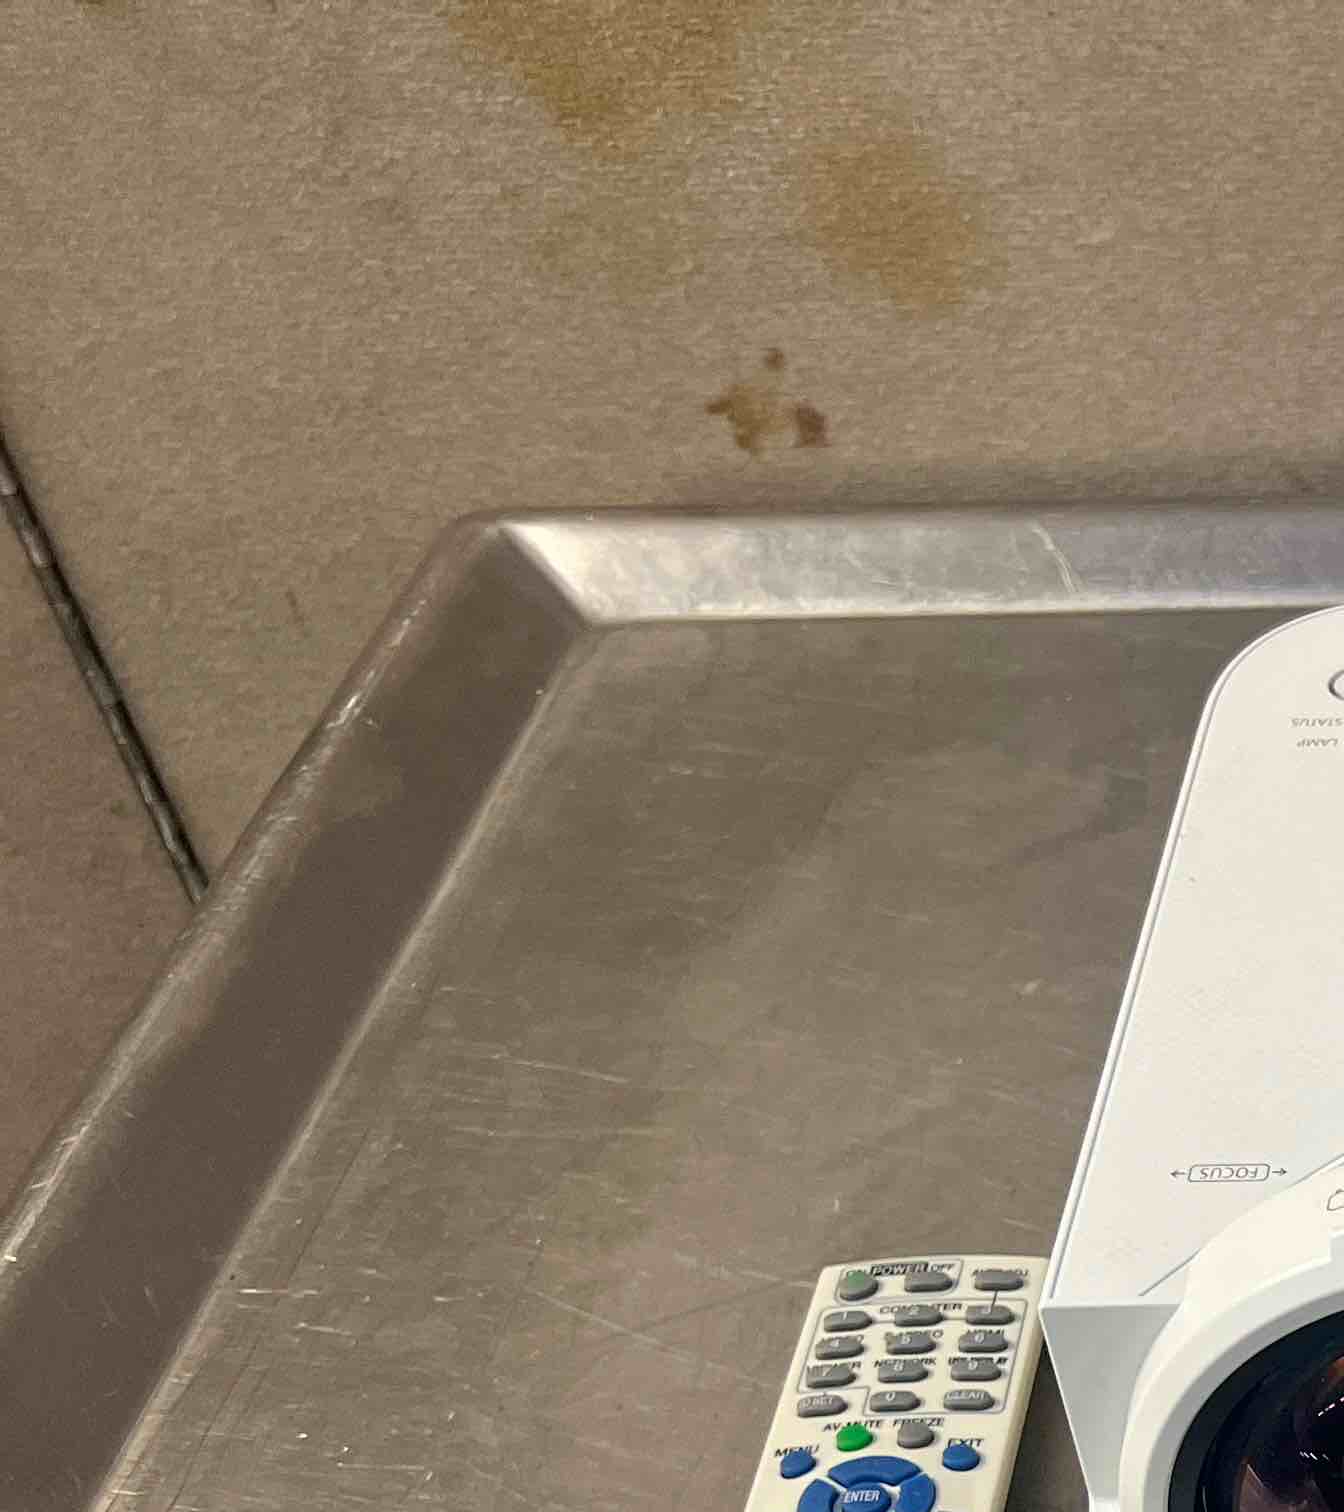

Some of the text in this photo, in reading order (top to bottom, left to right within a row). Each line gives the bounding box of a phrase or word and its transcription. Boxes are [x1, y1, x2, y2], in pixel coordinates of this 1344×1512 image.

[1291, 717, 1344, 728] STATUS
[1296, 738, 1339, 748] LAMP
[1199, 1166, 1258, 1180] FOCUS
[880, 1303, 962, 1314] COMTER
[823, 1418, 883, 1432] AVUTE
[947, 1438, 985, 1449] EXIT
[843, 1489, 881, 1503] ENTER
